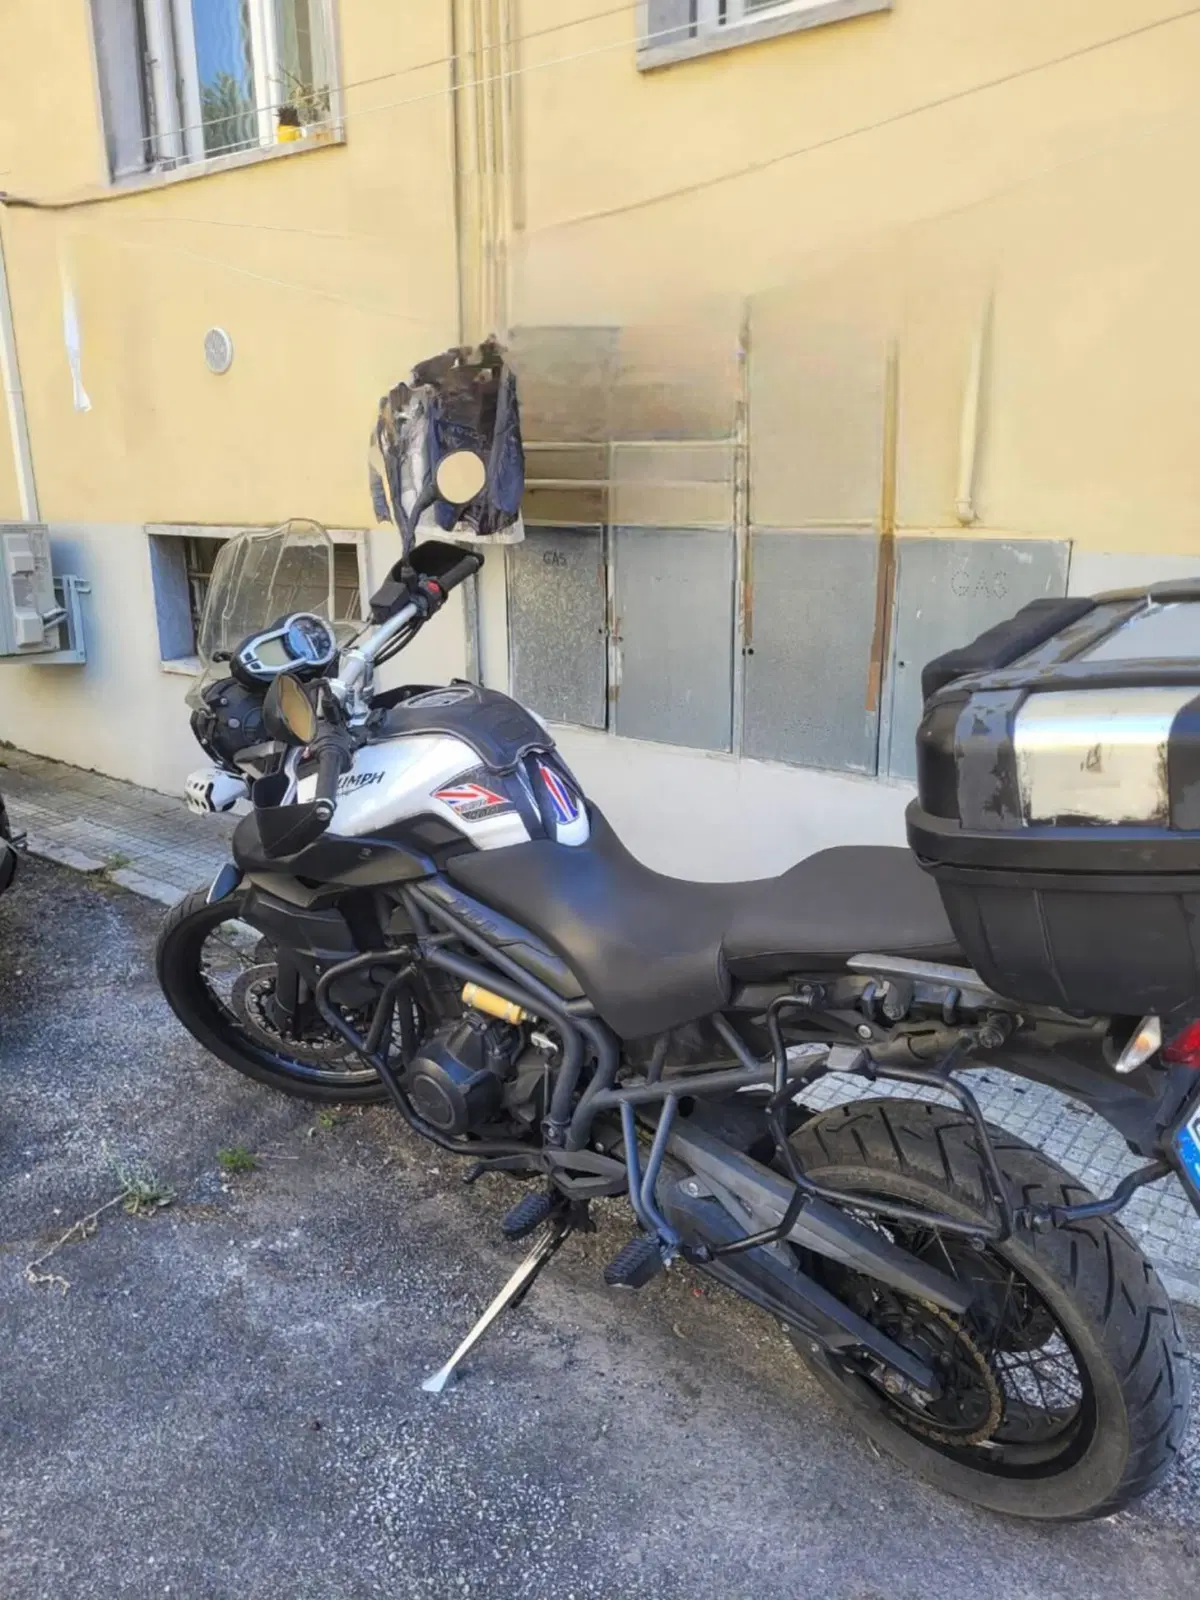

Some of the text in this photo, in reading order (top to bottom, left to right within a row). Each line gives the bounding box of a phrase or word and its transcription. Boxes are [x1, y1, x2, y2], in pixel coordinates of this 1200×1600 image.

[543, 550, 567, 567] GAS
[951, 570, 1008, 599] GAS
[337, 770, 386, 792] UMPH
